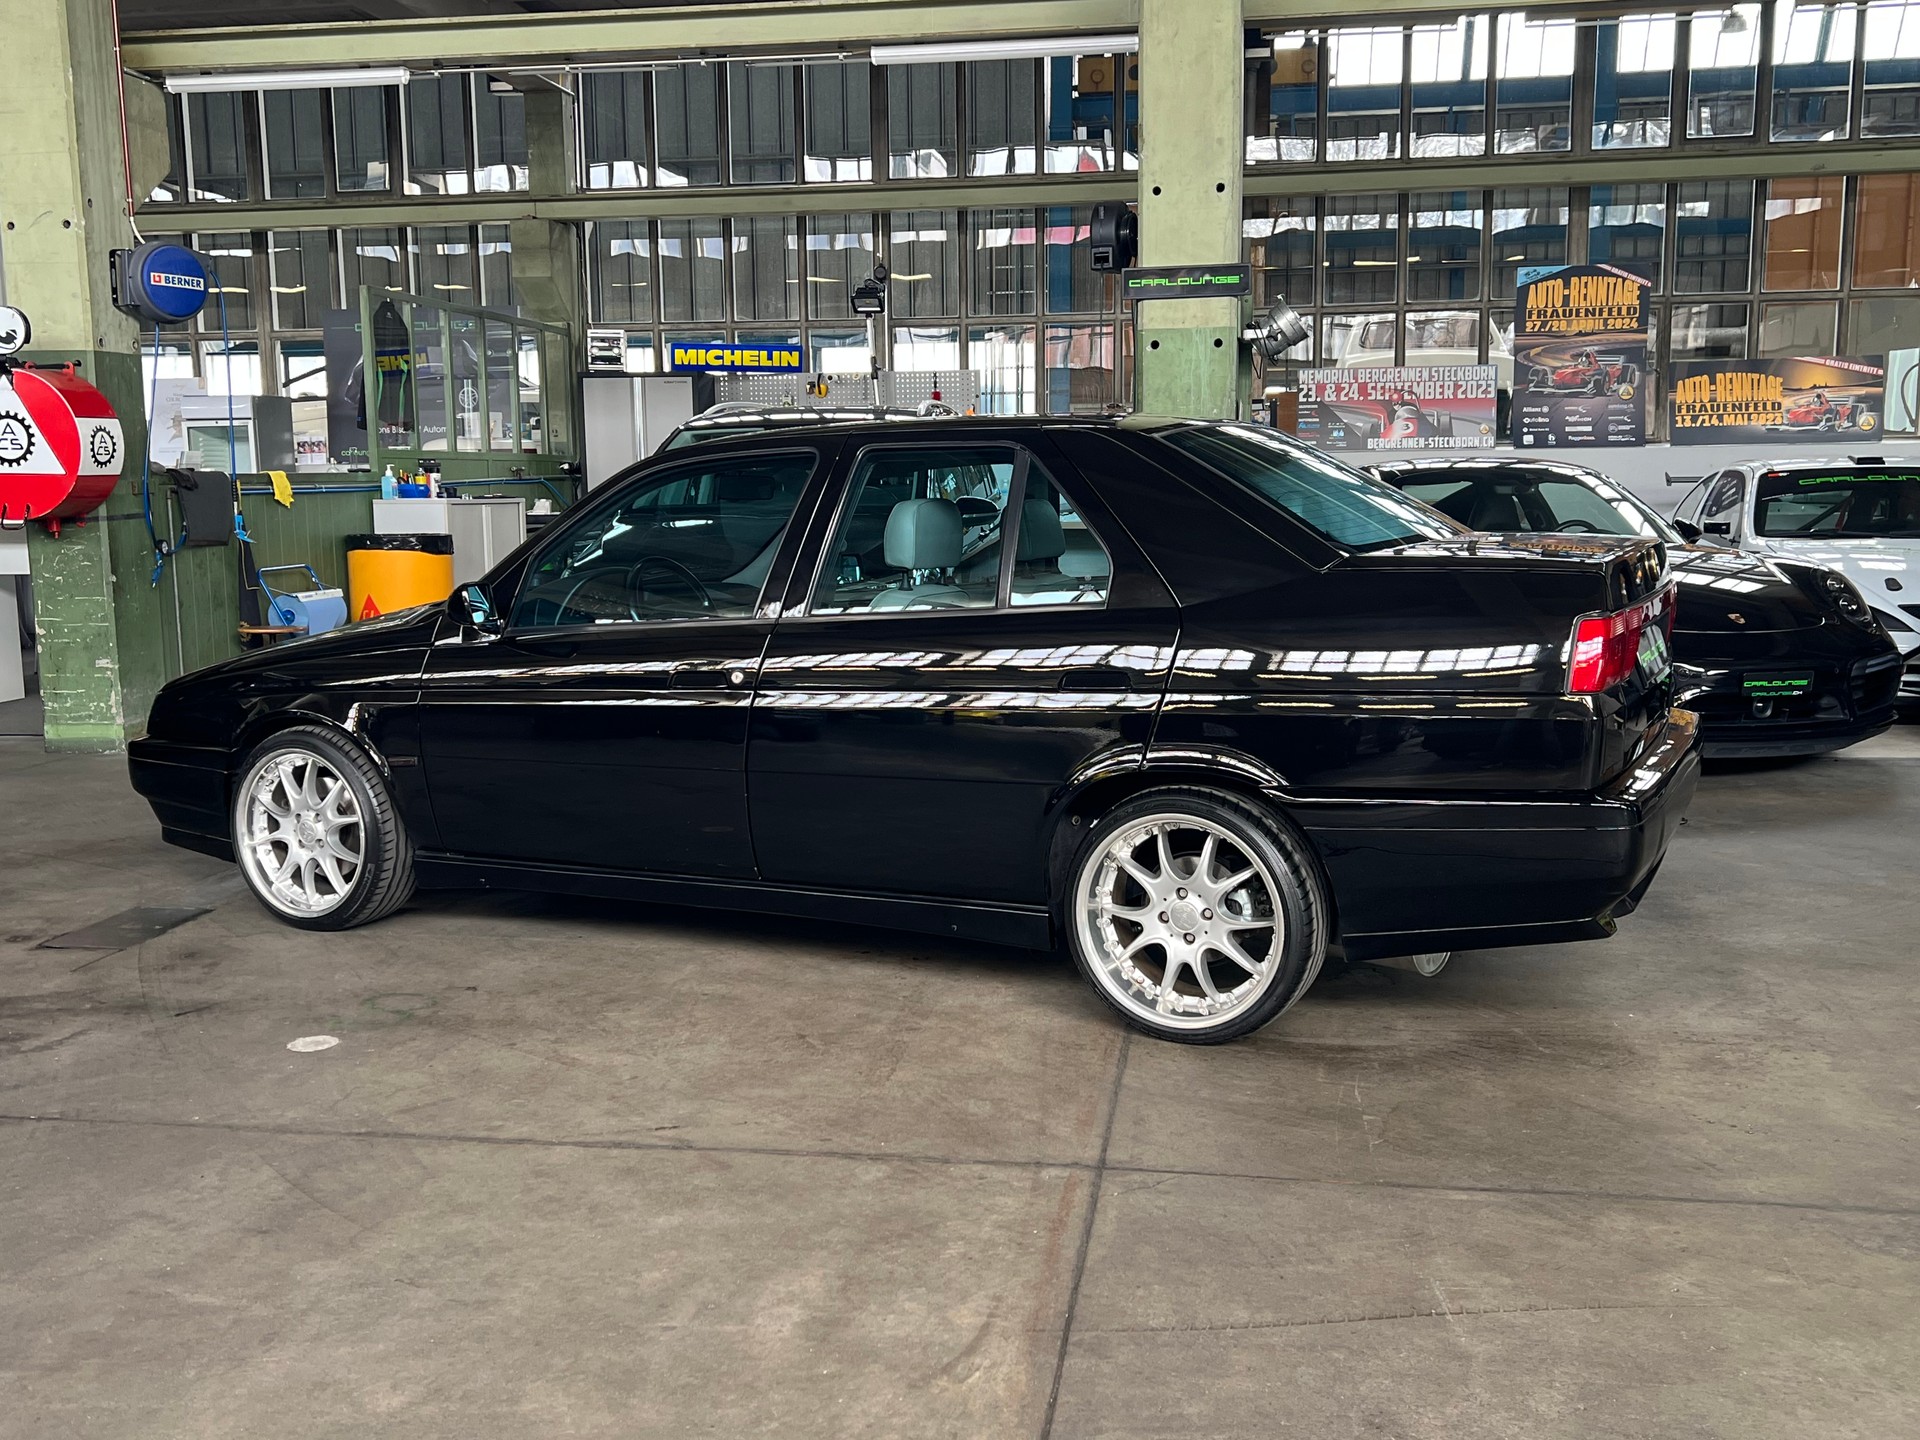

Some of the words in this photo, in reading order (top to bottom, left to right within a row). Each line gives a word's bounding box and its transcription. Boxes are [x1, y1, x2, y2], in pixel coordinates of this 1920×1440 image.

[164, 275, 202, 289] BERNER
[1128, 275, 1241, 288] CARLOUNGE
[1526, 276, 1641, 309] AUTO-RENNTAGE
[1527, 306, 1638, 320] FRAUENFELD
[1607, 318, 1639, 330] 2024
[674, 348, 800, 367] MICHELIN
[1825, 358, 1849, 371] GRATIS
[1848, 361, 1878, 376] EINTRITT
[1299, 368, 1358, 384] MEMORIAL
[1358, 367, 1431, 384] BERGRENNEN
[1431, 366, 1496, 382] STECKBORN
[1298, 384, 1321, 402] 23.
[1325, 384, 1337, 400] &
[1341, 383, 1364, 400] 24.
[1457, 381, 1496, 399] 2023
[1676, 372, 1784, 404] AUTO-RENNTAGE
[1677, 402, 1783, 414] FRAUENFELD
[1750, 412, 1783, 426] 2023
[1402, 423, 1411, 432] 3
[1367, 436, 1495, 449] BERGRENNEN-STECKBORN.CH
[1743, 679, 1809, 687] CARLOUNGE
